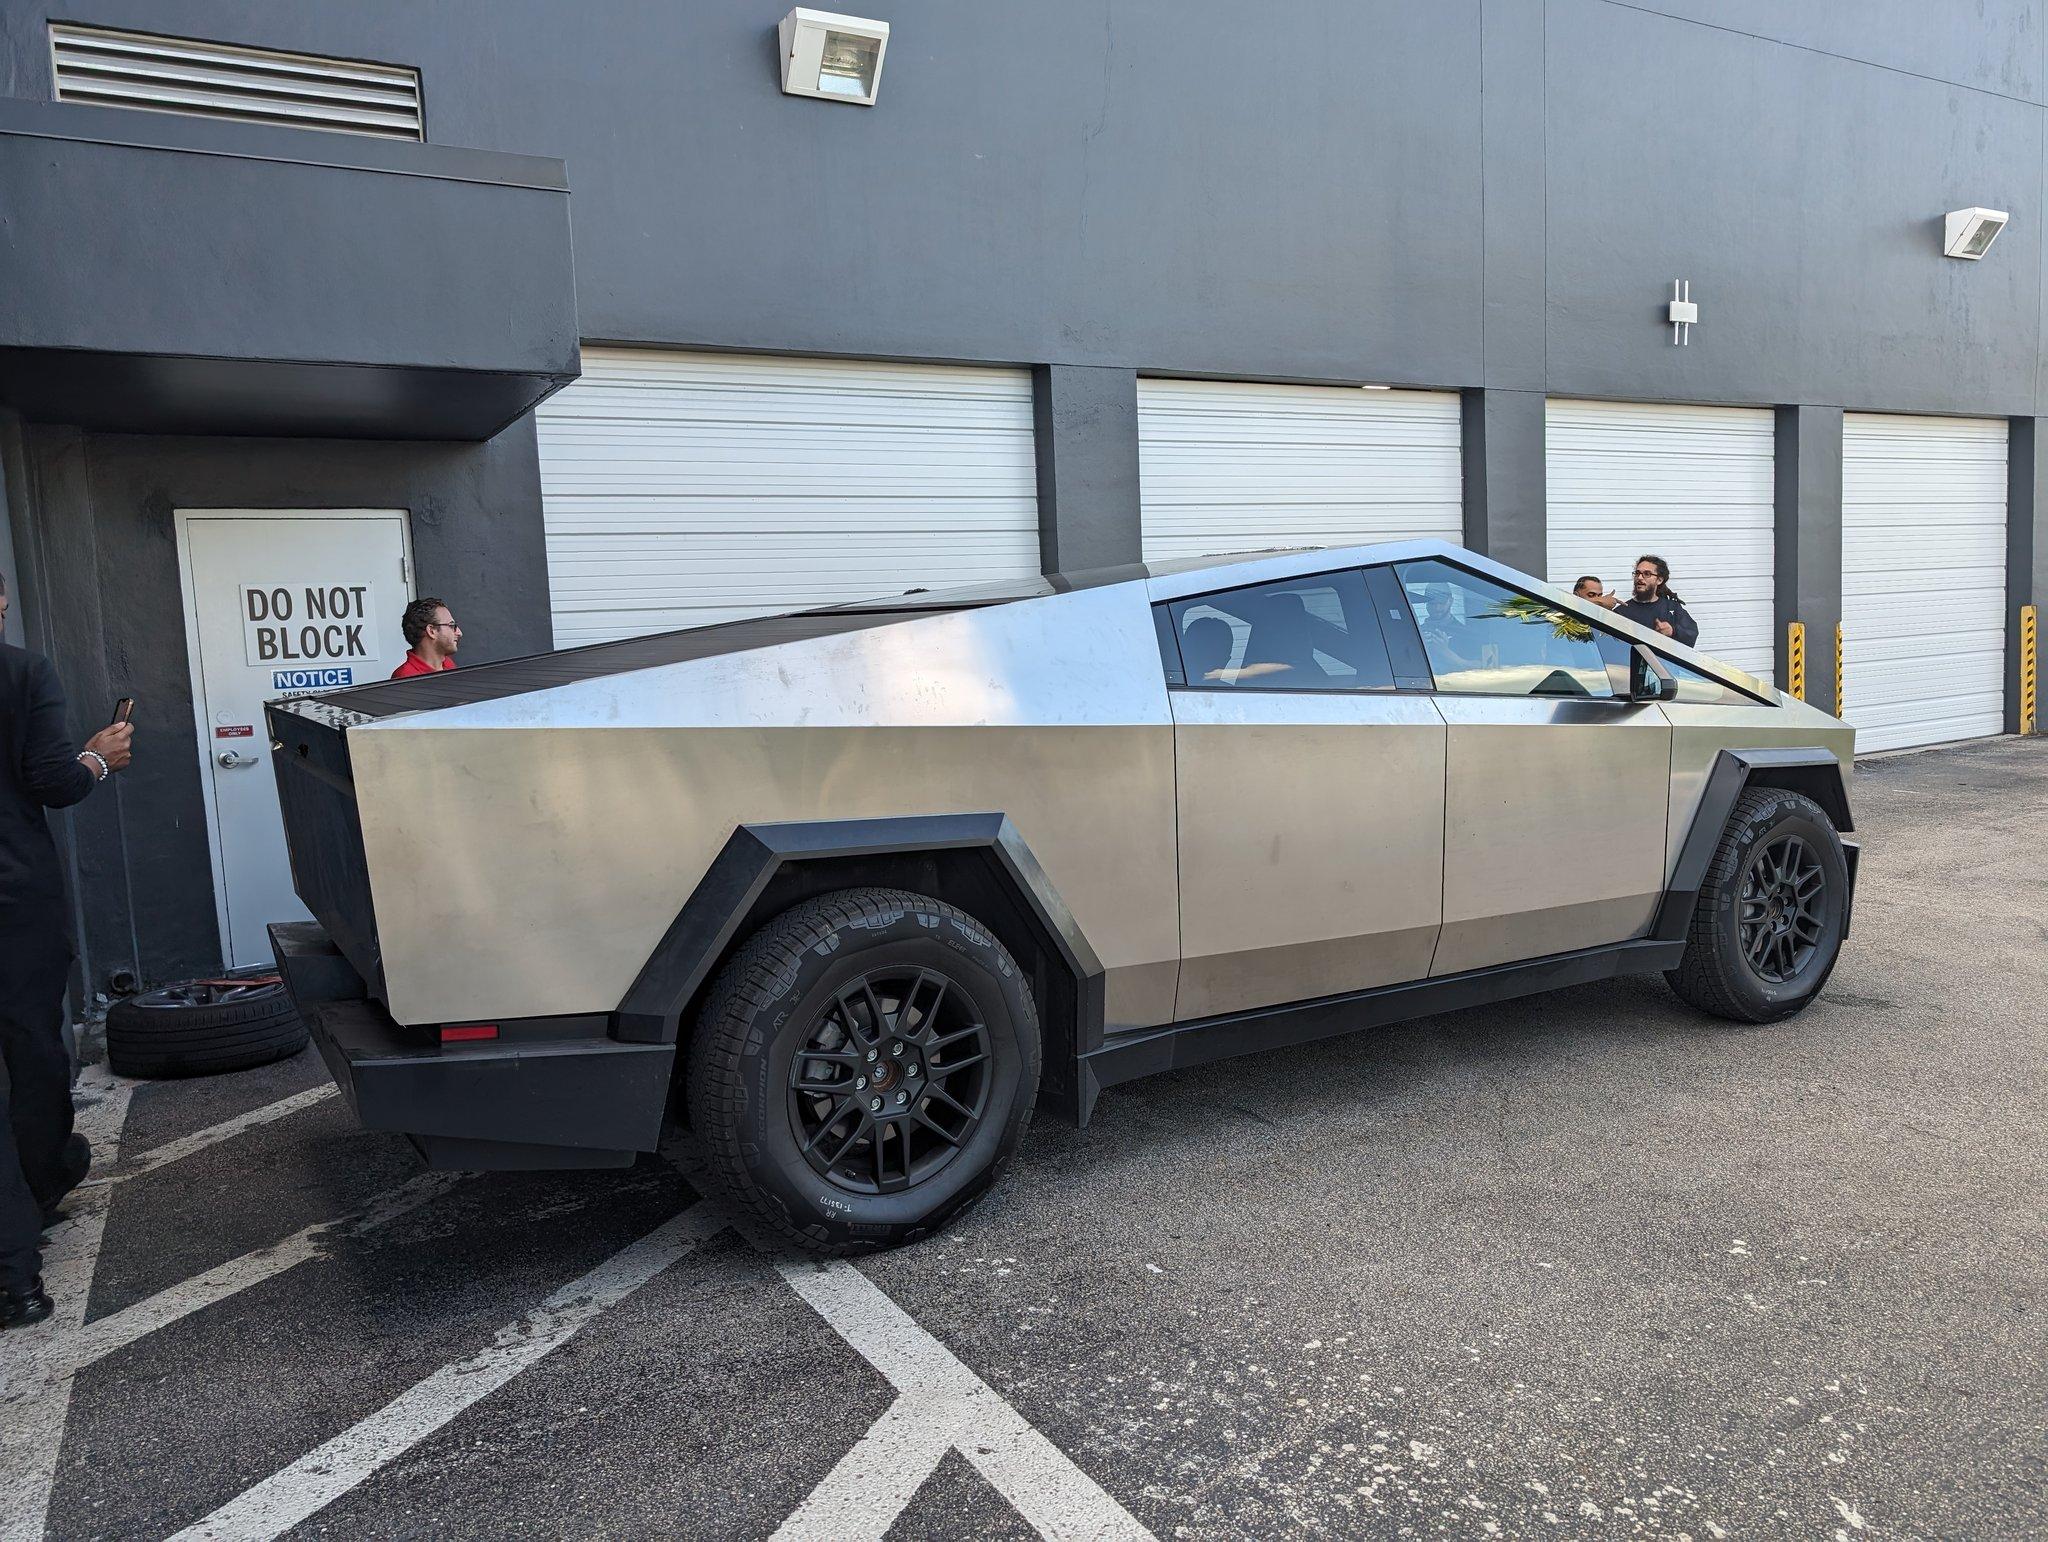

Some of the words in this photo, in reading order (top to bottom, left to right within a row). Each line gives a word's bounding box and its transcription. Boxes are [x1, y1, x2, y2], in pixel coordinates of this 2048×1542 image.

[246, 587, 293, 621] DO
[305, 586, 367, 620] NOT
[256, 624, 367, 660] BLOCK
[276, 668, 349, 688] NOTICE
[758, 1058, 769, 1141] SCORPION
